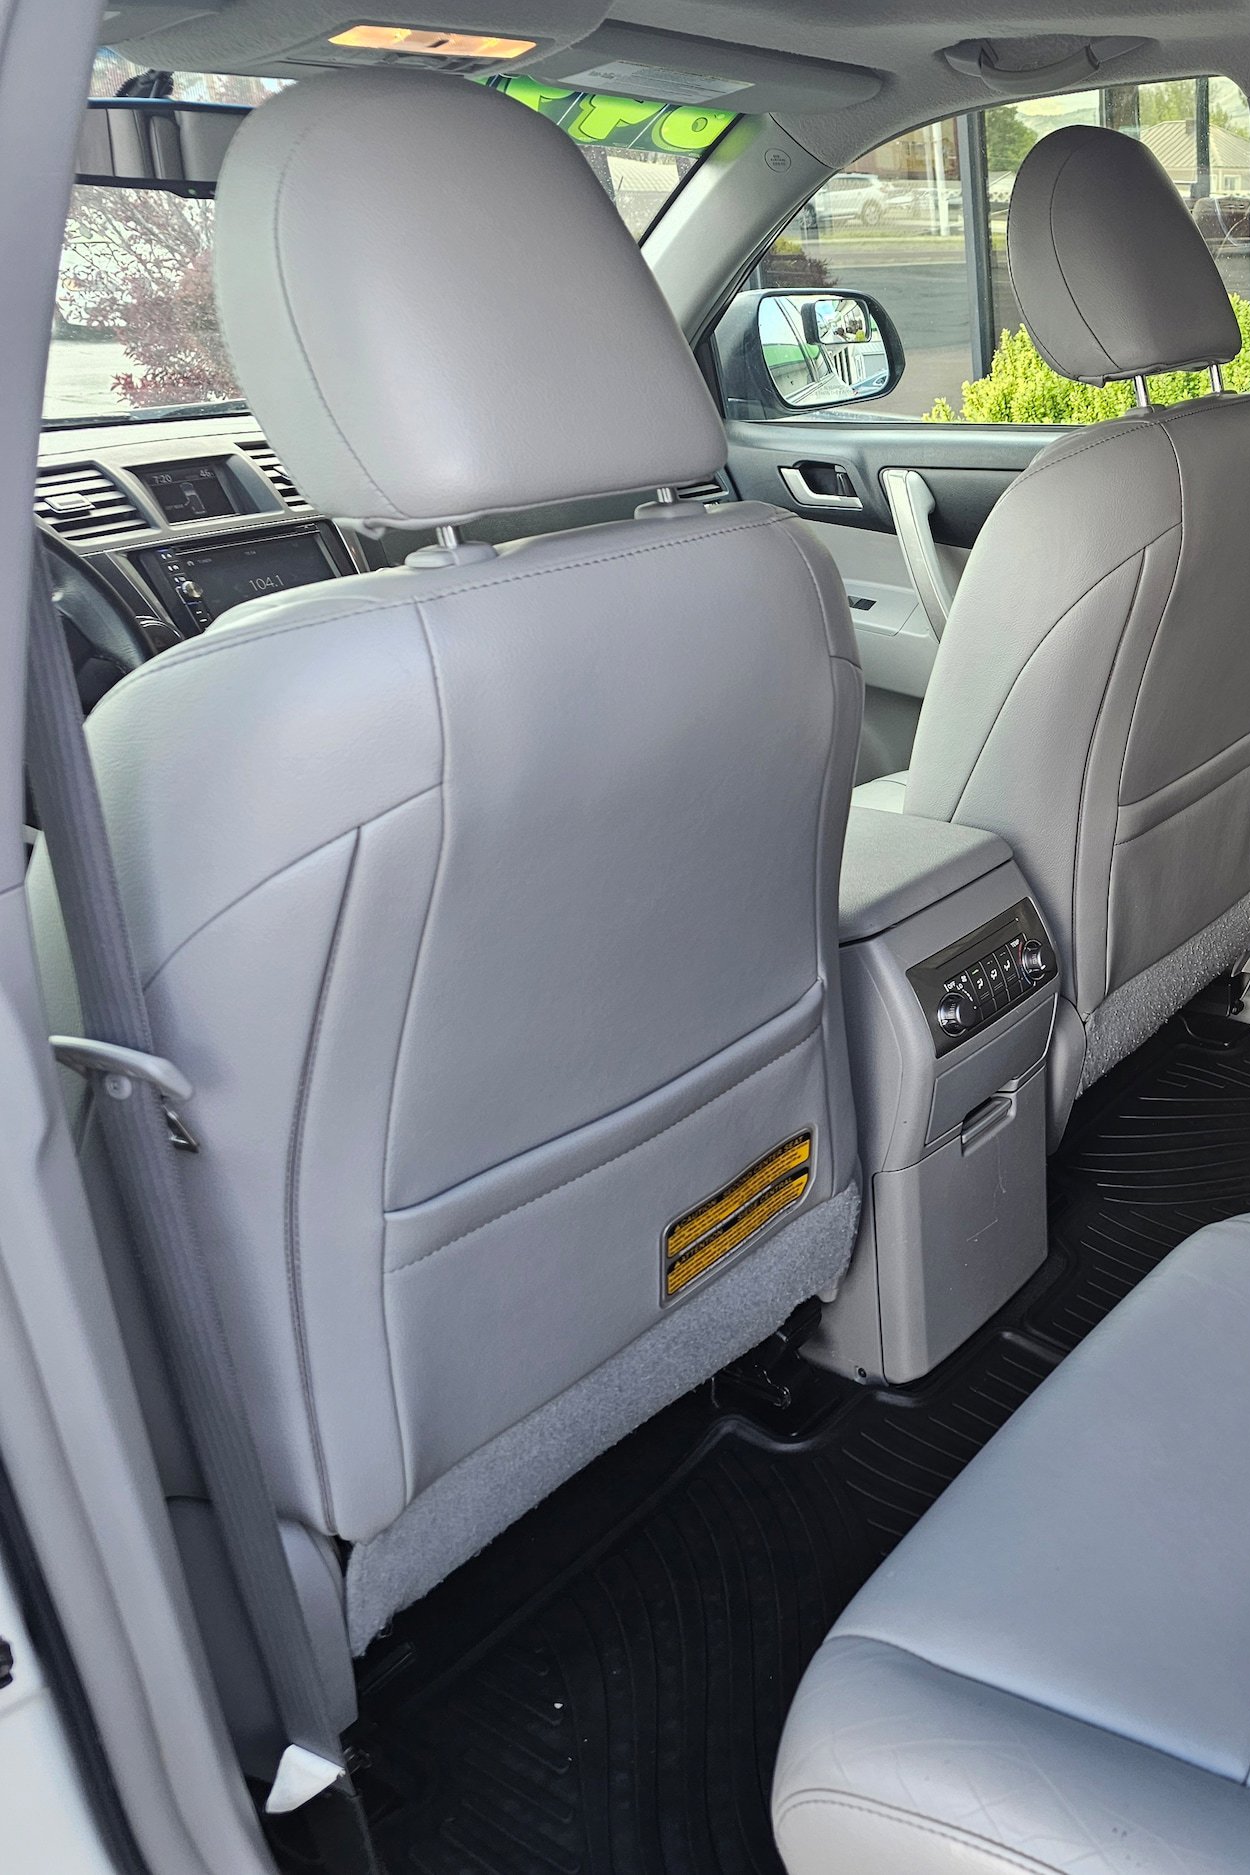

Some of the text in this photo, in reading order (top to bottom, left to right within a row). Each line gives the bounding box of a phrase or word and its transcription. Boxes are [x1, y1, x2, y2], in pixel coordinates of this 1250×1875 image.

[151, 474, 172, 484] 7:20
[249, 574, 284, 592] 104.1
[946, 981, 956, 990] OFF
[680, 1200, 718, 1226] CAUTION
[753, 1149, 782, 1174] CENTER
[783, 1135, 804, 1151] SEAT
